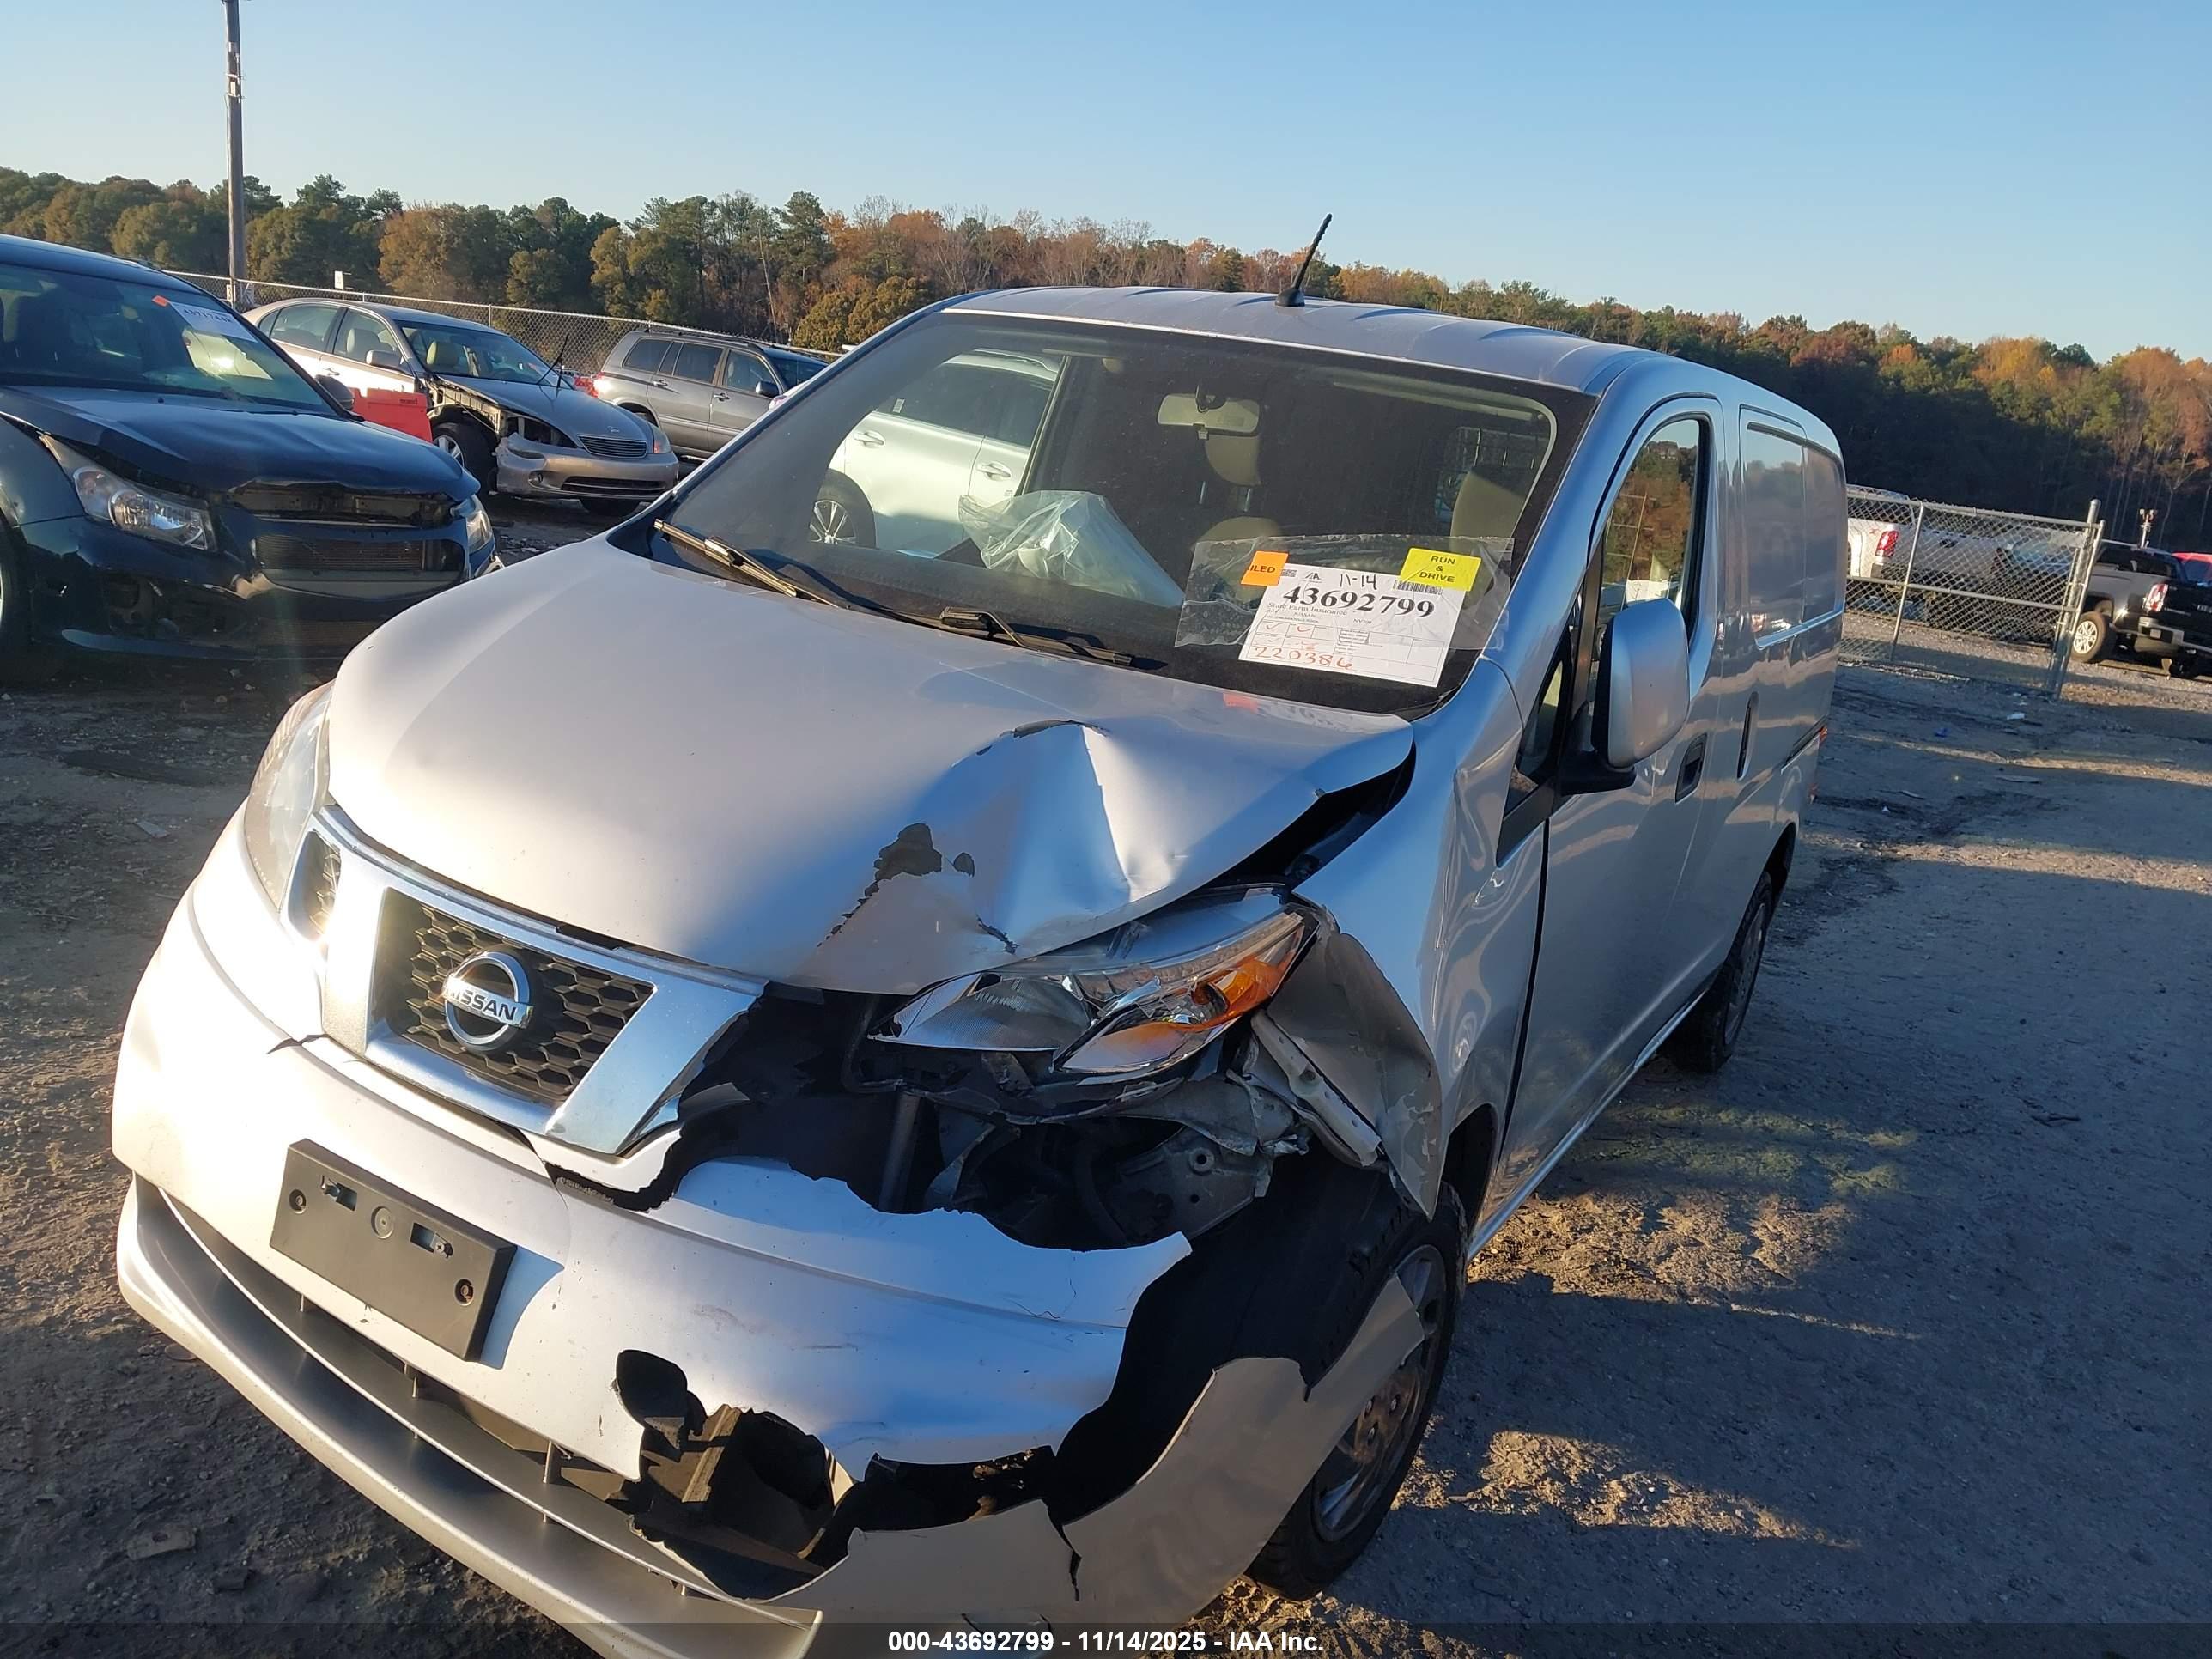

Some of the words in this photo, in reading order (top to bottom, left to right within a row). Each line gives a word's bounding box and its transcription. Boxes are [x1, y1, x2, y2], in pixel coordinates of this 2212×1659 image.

[1340, 574, 1377, 590] 11-14
[1419, 572, 1455, 582] DRIVE
[1283, 586, 1435, 618] 43692799
[446, 985, 517, 1021] NISSAN
